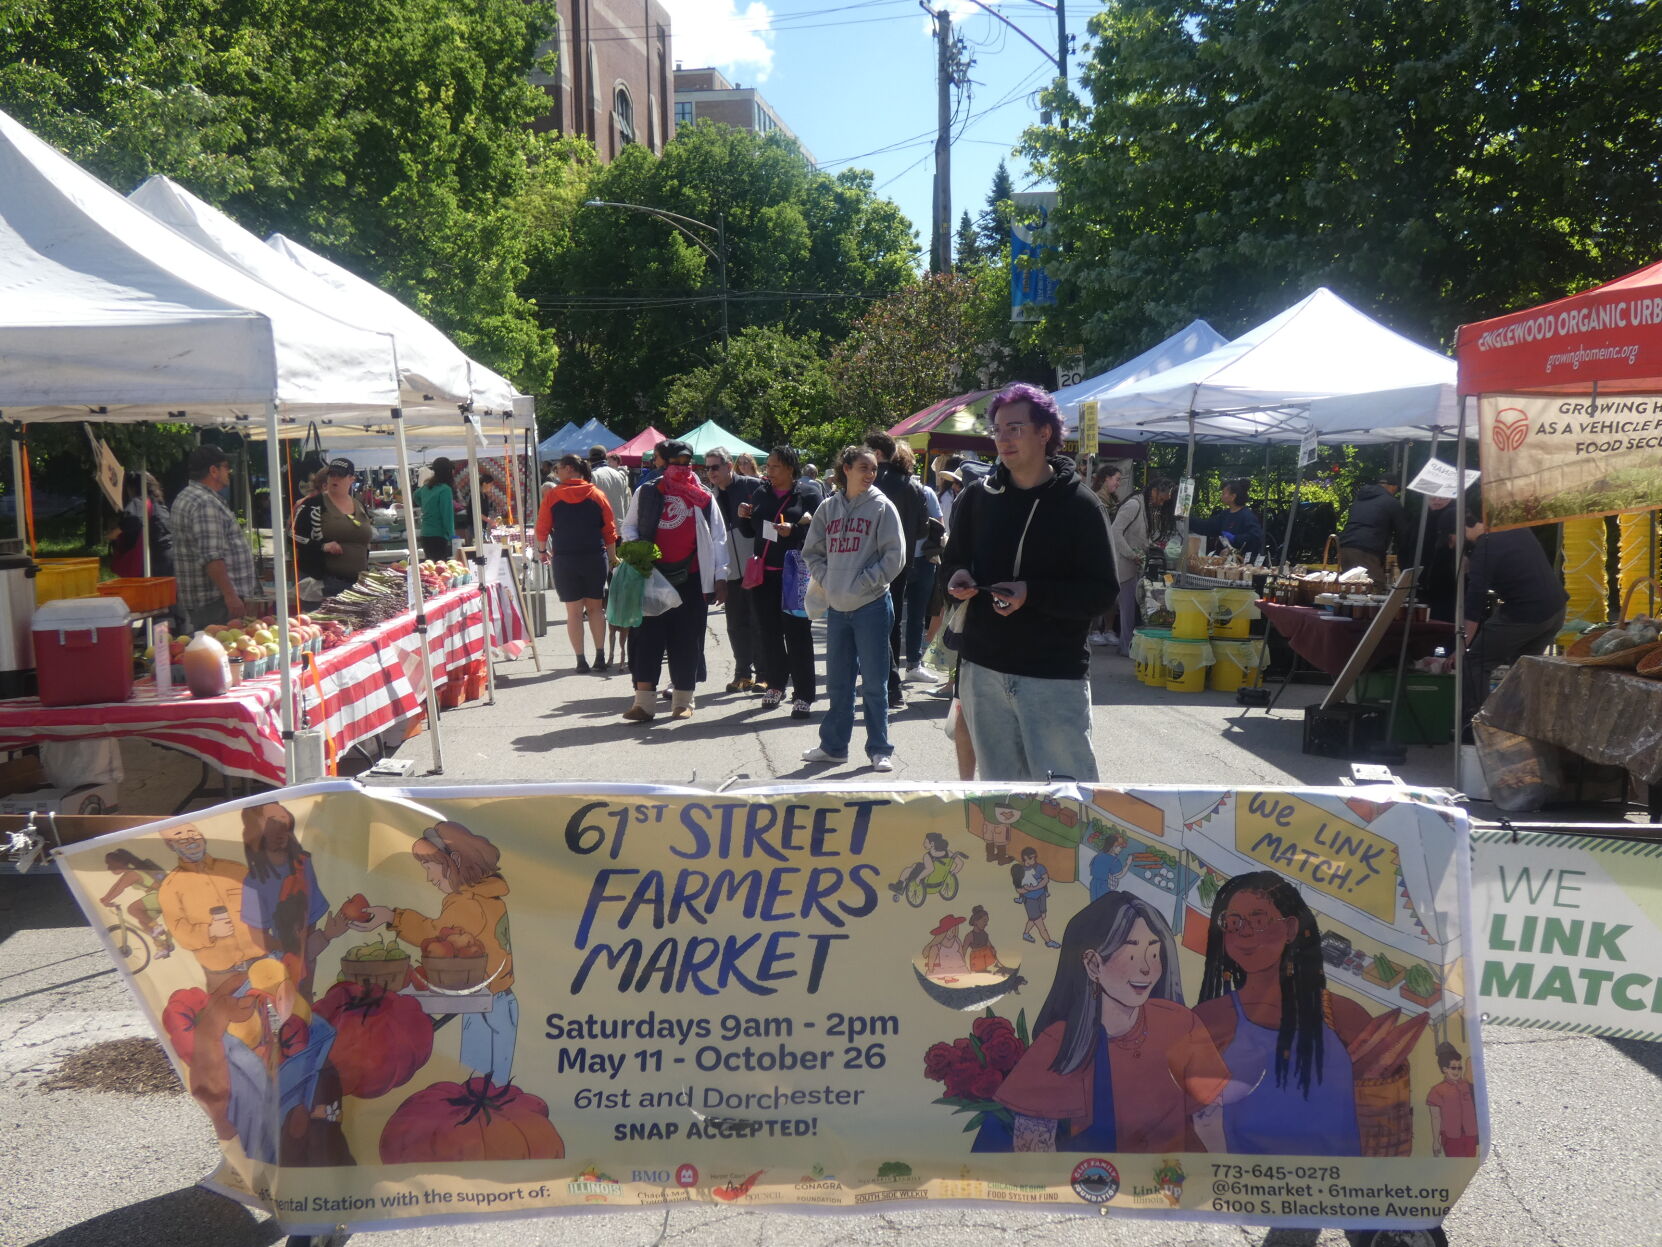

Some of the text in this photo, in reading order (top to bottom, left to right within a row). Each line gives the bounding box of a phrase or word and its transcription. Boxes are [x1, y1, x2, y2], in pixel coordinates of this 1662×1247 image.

[1478, 297, 1662, 351] ENGLEWOOD ORGANIC URB
[1545, 341, 1639, 373] growinghomeinc.org
[1061, 372, 1081, 387] 20
[1558, 401, 1648, 416] GROWING
[1535, 421, 1557, 435] AS
[1561, 422, 1573, 435] A
[1579, 420, 1652, 434] VEHICLE
[1575, 439, 1622, 455] FOOD
[669, 799, 892, 863] STREET
[1248, 791, 1385, 875] We LINK
[1251, 832, 1371, 893] MATCH!
[1498, 865, 1587, 909] WE
[574, 863, 881, 951] FARMERS
[1488, 913, 1635, 962] LINK
[569, 930, 850, 996] MARKET
[545, 1010, 712, 1045] Saturdays
[720, 1013, 793, 1042] 9am
[825, 1012, 900, 1044] 2pm
[557, 1047, 627, 1080] May
[633, 1049, 664, 1073] 11
[694, 1043, 834, 1072] October
[842, 1043, 887, 1070] 26
[573, 1085, 866, 1110] 61st and Dorchester
[614, 1122, 679, 1142] SNAP
[631, 1169, 671, 1183] BMO
[1074, 1160, 1117, 1178] CLIF FAMILY
[1210, 1163, 1341, 1181] 773-645-0278
[568, 1182, 622, 1197] ILLINOIS
[794, 1182, 843, 1192] CONAGRA
[987, 1190, 1059, 1201] FOOD SYSTEM FUND
[1074, 1183, 1117, 1203] FOUNDATION
[1212, 1181, 1450, 1202] @61market 61market.org
[311, 1194, 376, 1212] Station
[380, 1191, 419, 1208] with
[423, 1188, 453, 1204] the
[456, 1187, 524, 1206] support
[527, 1185, 551, 1199] of:
[1212, 1198, 1451, 1217] 6100 S. Blackstone Avenue
